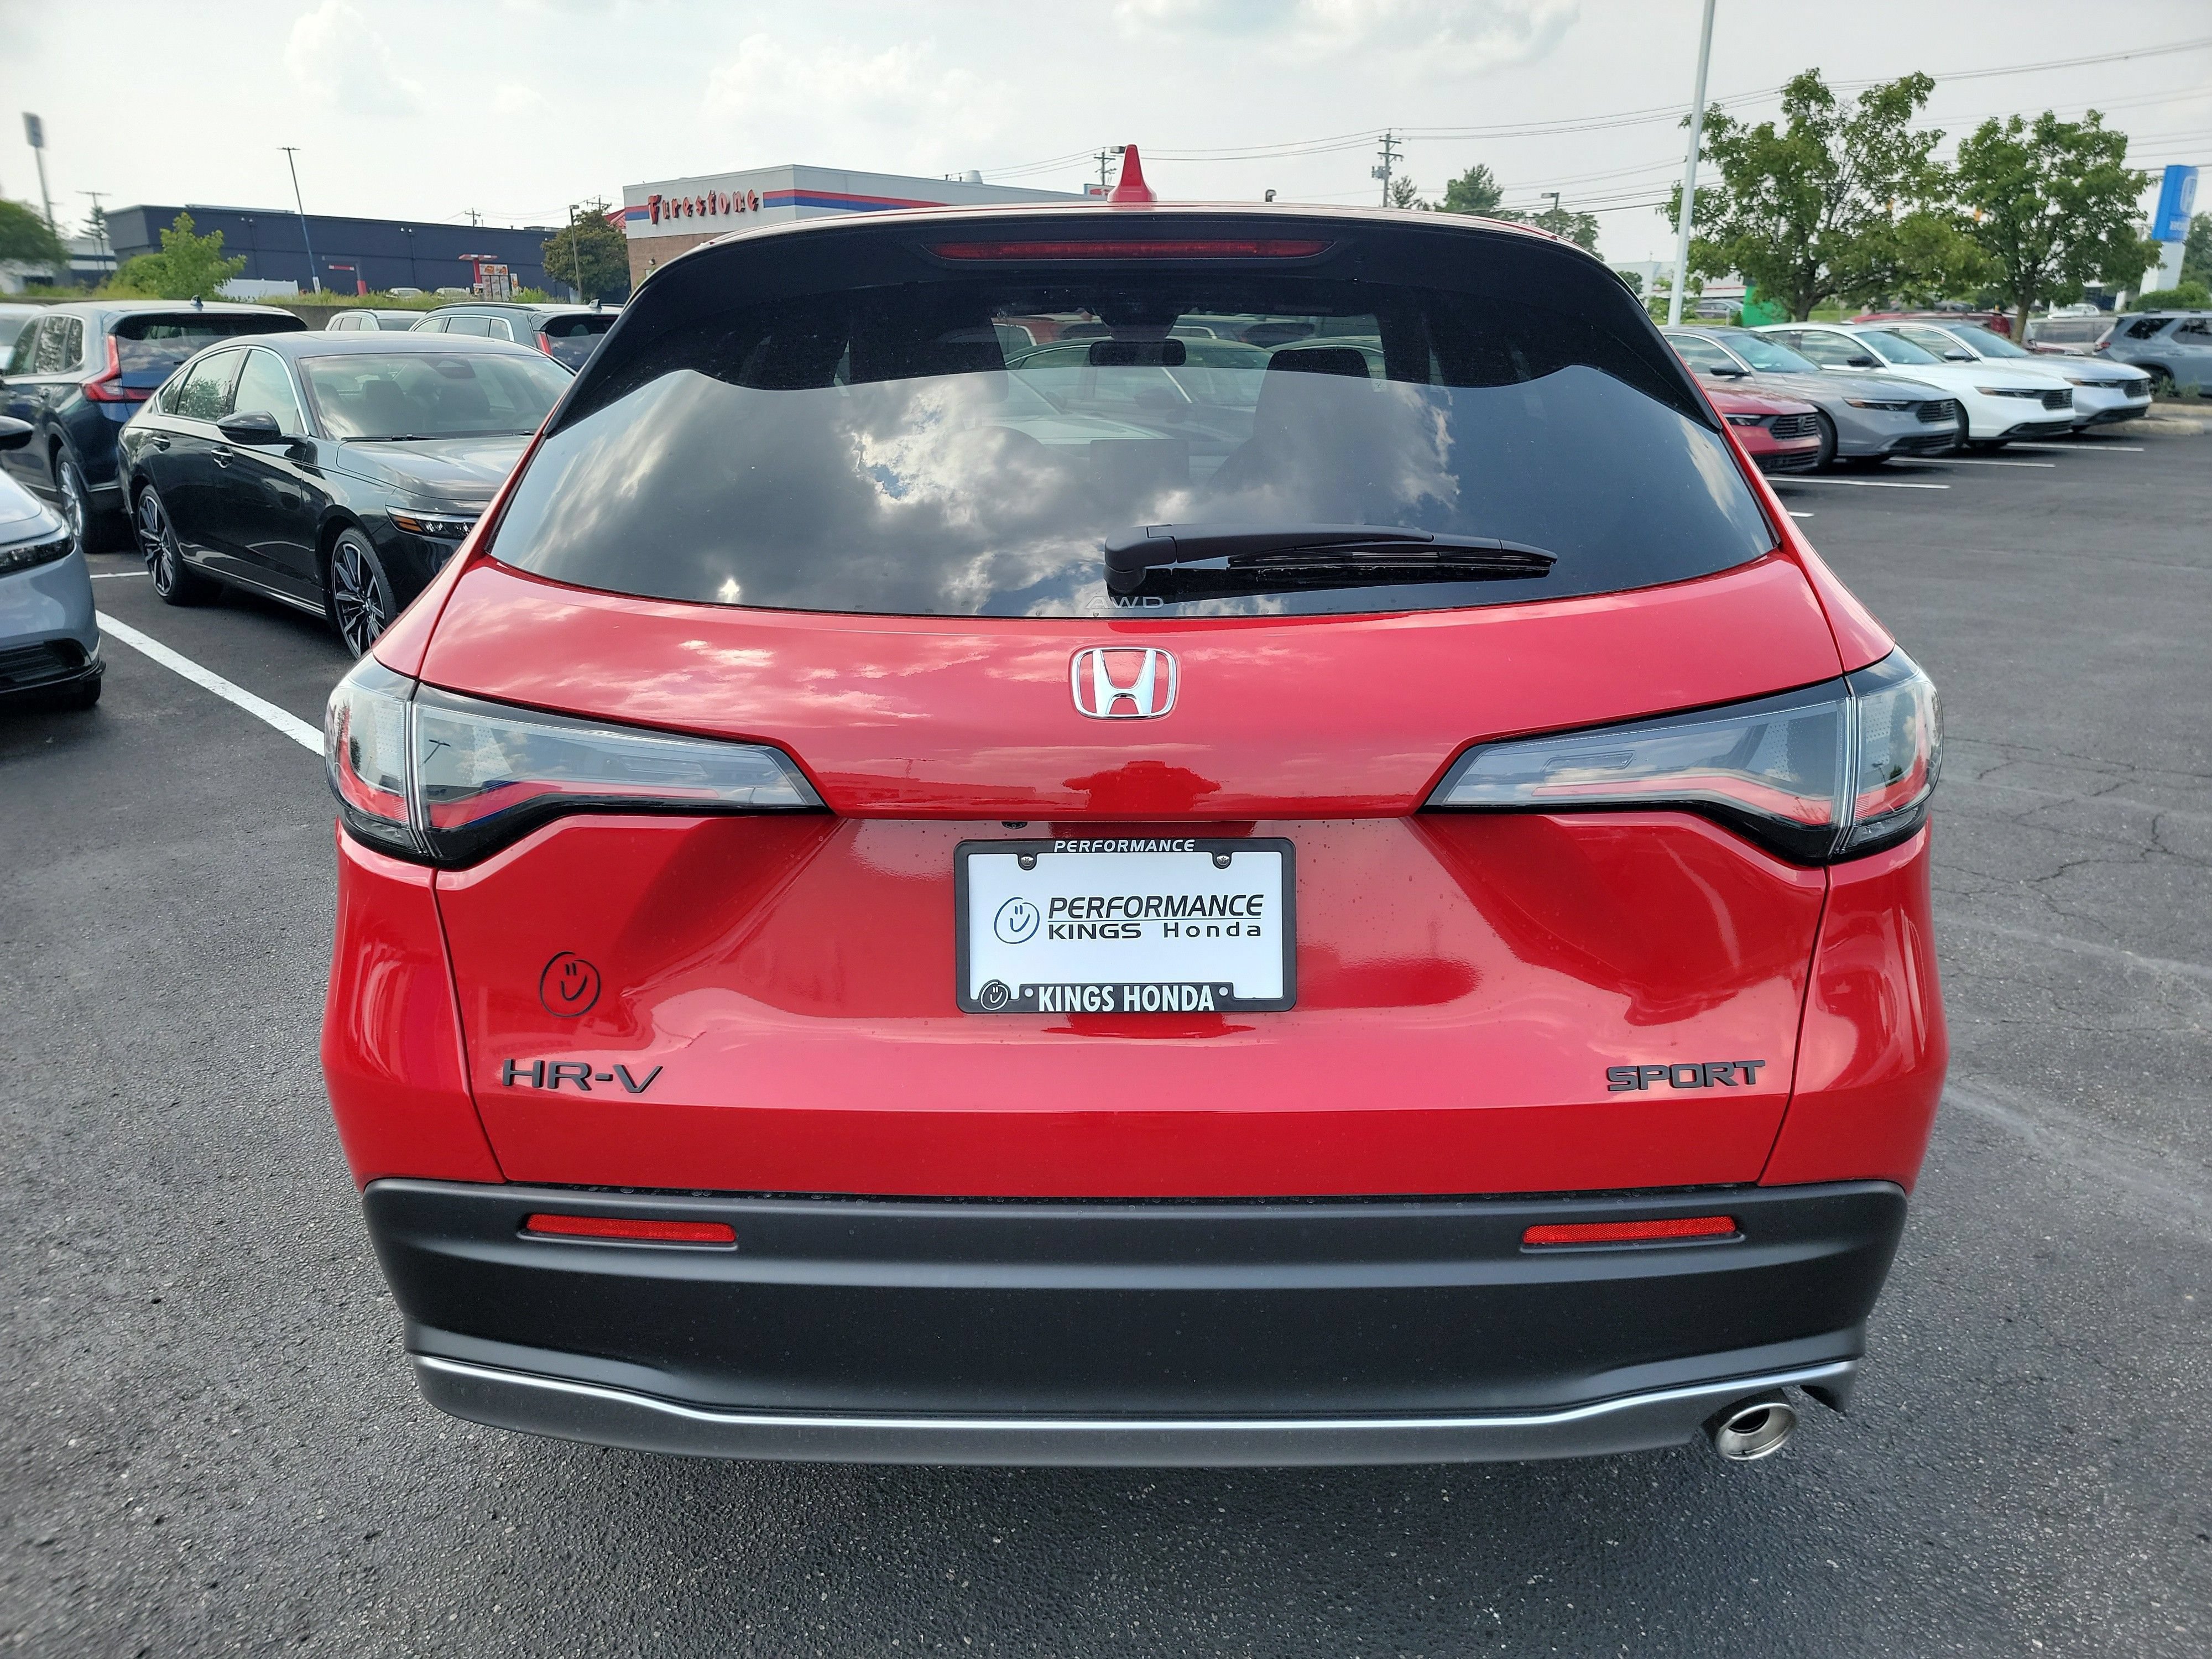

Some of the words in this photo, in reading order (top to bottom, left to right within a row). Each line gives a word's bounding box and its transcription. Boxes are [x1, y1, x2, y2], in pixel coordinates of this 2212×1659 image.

[648, 189, 759, 225] Firestone
[1084, 596, 1165, 609] AWD
[1053, 839, 1196, 853] PERFORMANCE
[1049, 894, 1264, 919] PERFORMANCE
[1049, 922, 1142, 940] KINGS
[1164, 921, 1261, 938] Honda
[1039, 985, 1116, 1012] KINGS
[1124, 984, 1215, 1011] HONDA
[502, 1058, 664, 1094] HR-V
[1606, 1059, 1766, 1092] SPORT
